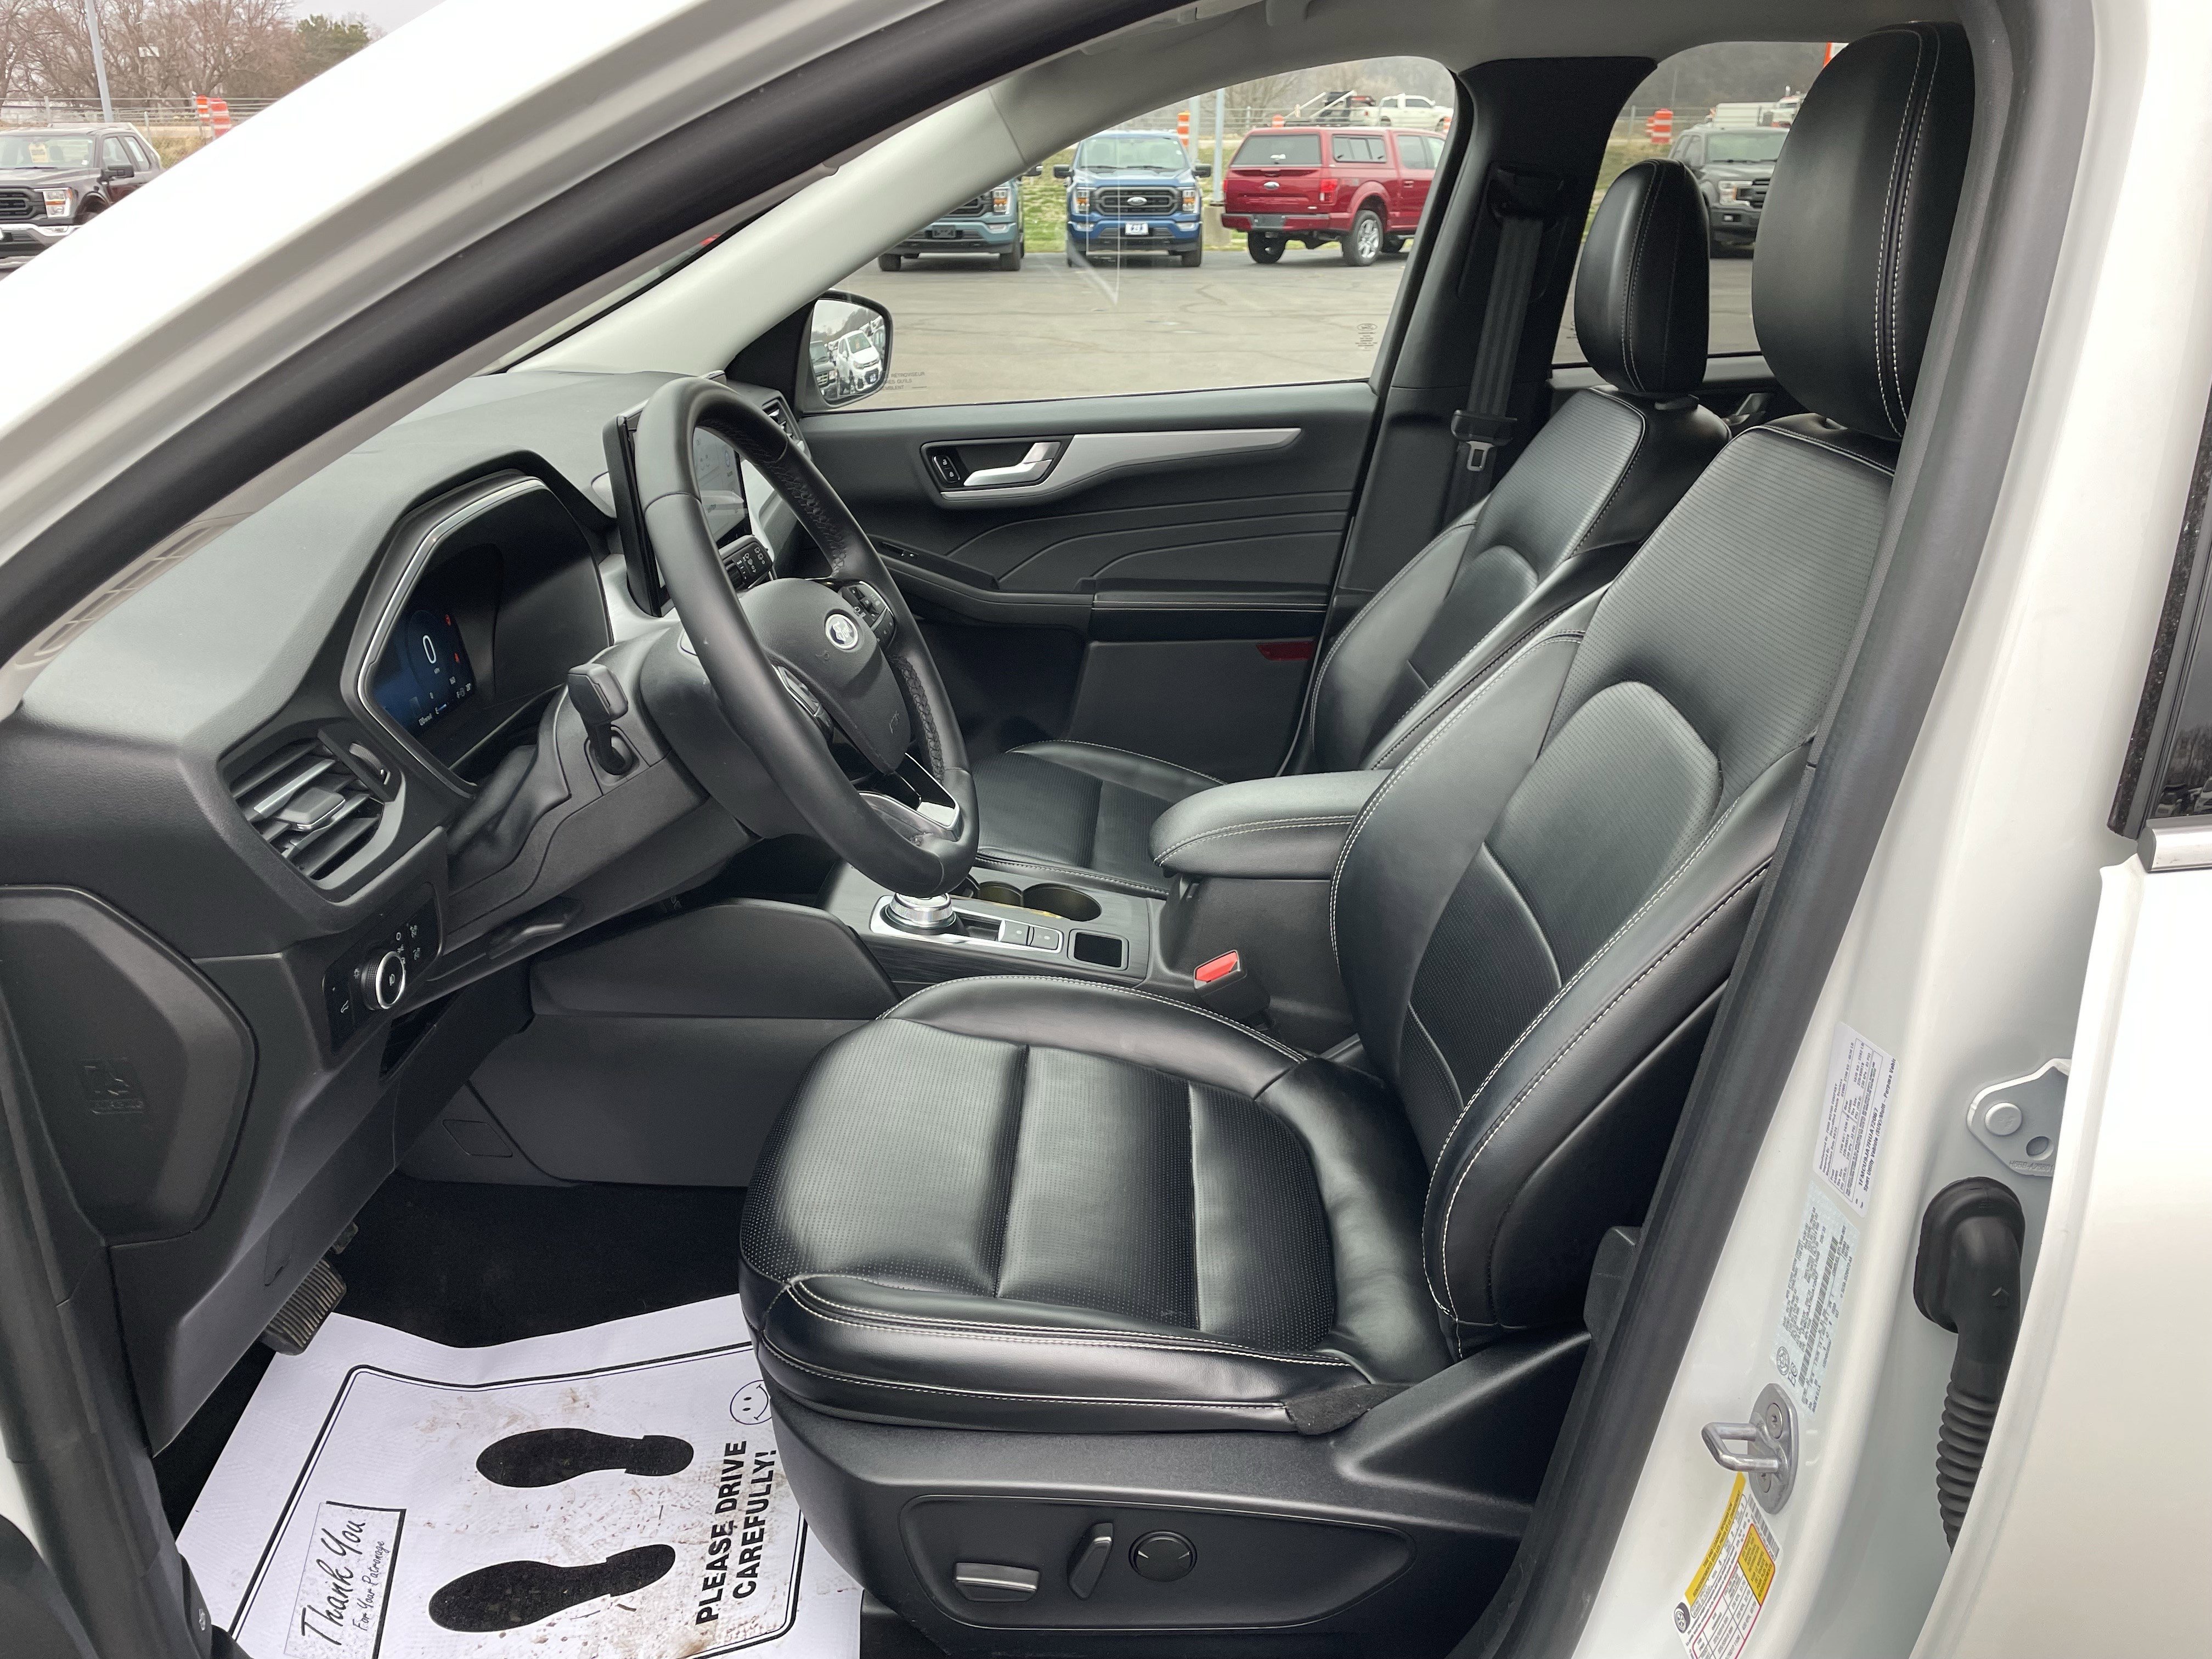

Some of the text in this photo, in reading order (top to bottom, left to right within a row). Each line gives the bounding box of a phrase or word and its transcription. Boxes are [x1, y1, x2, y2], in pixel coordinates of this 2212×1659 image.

[422, 635, 437, 664] 0
[1870, 1136, 1878, 1158] Vehicle
[695, 1441, 747, 1626] PLEASE DRIVE
[732, 1450, 776, 1599] CAREFULLY!
[301, 1520, 366, 1645] Thank You
[352, 1541, 391, 1631] For Your Patronage
